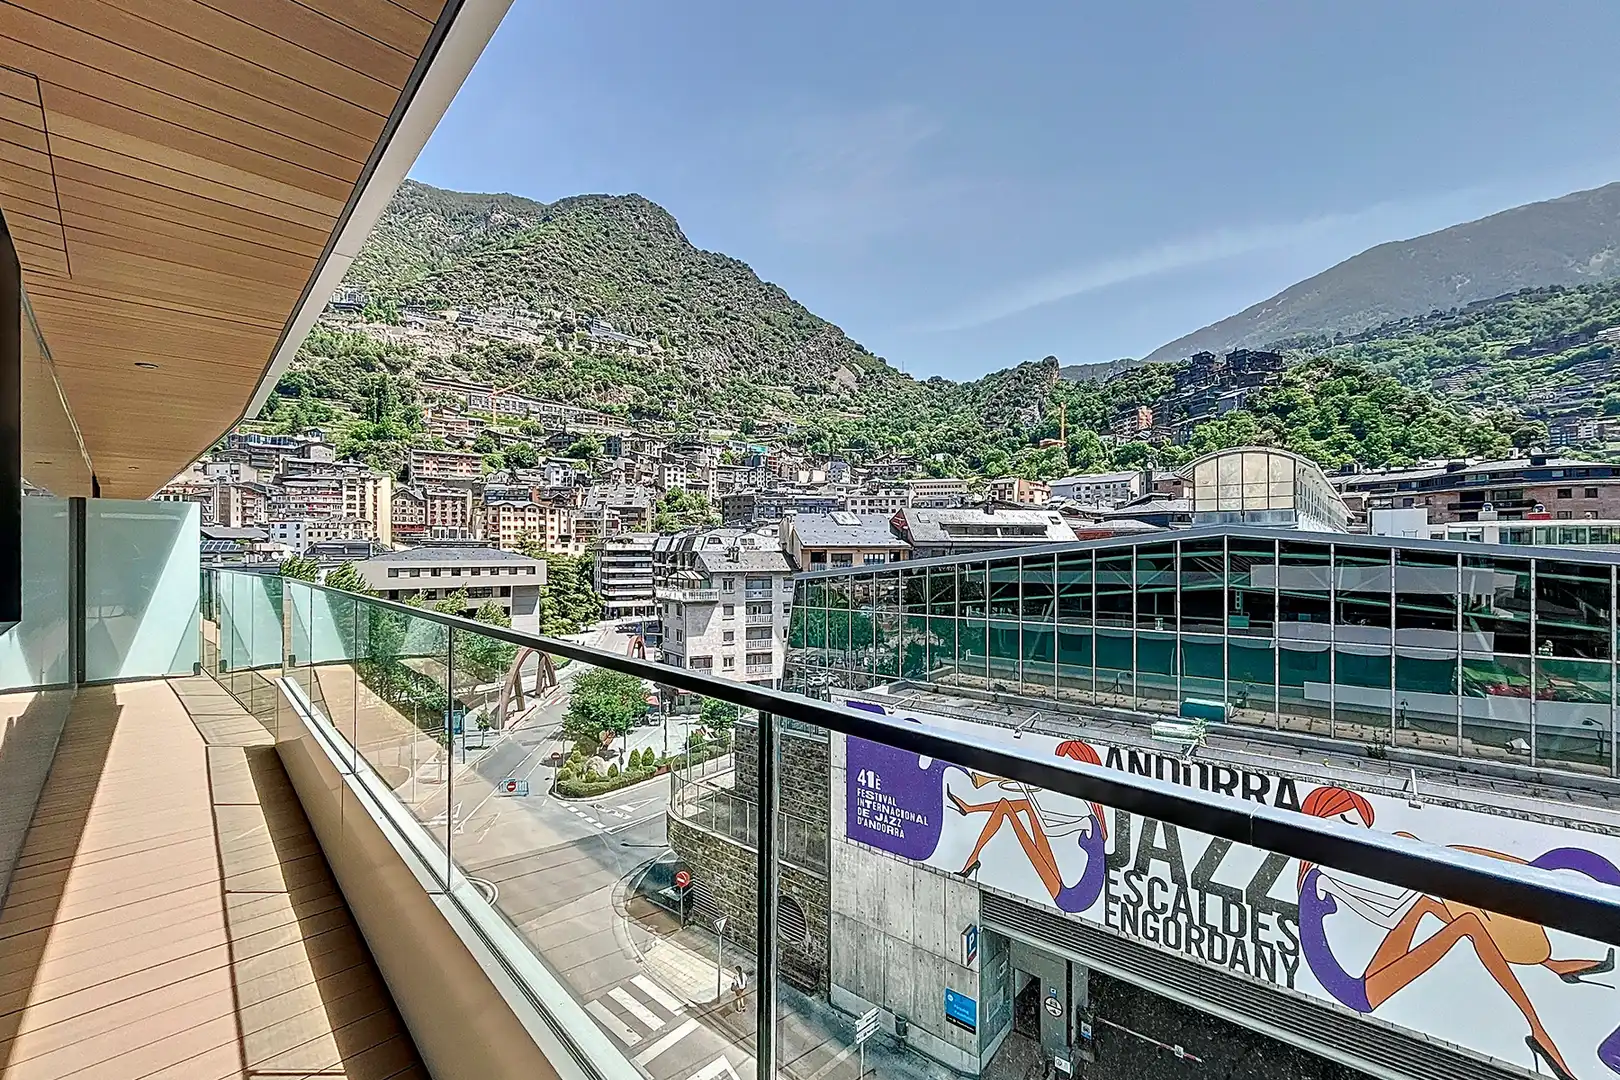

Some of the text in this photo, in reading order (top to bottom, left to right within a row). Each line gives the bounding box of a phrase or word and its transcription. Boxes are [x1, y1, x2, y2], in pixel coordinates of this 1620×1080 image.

[857, 787, 898, 807] FESTIVAL
[857, 797, 929, 827] INTERNACIONAL
[857, 806, 902, 828] DE JAZZ
[857, 816, 905, 839] D'ANDORRA
[1105, 866, 1299, 957] ESCALDES
[969, 932, 975, 951] P
[1105, 897, 1299, 990] ENGORDANY
